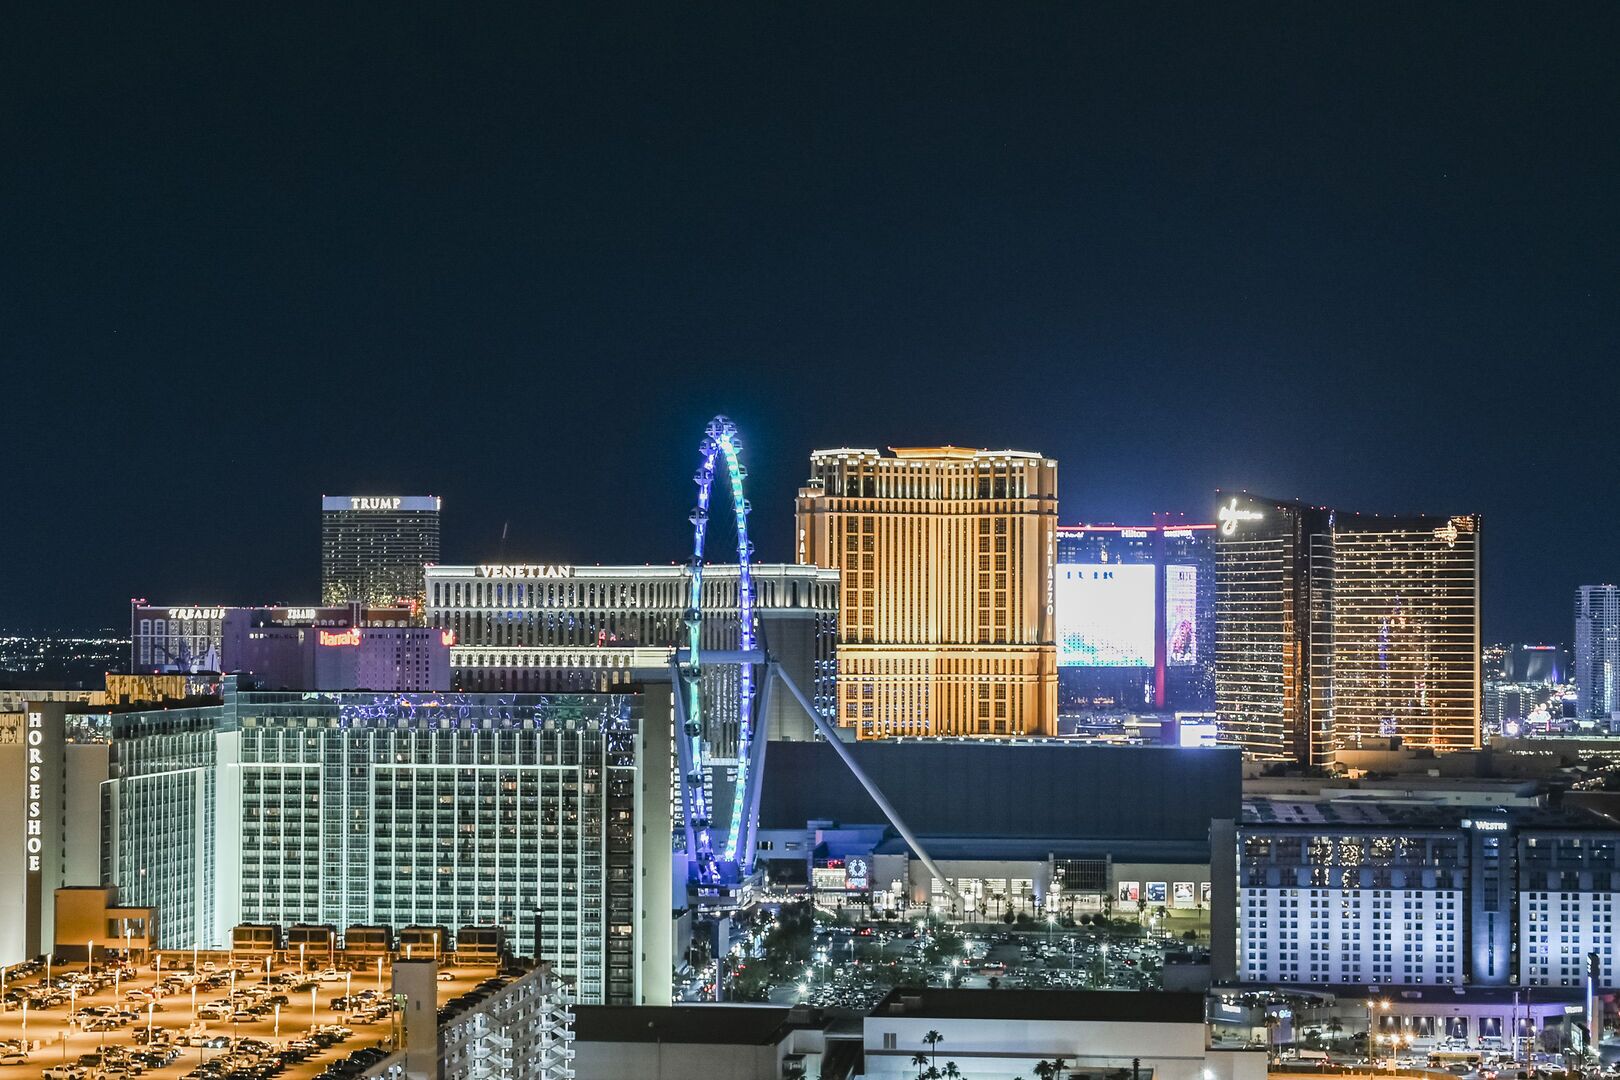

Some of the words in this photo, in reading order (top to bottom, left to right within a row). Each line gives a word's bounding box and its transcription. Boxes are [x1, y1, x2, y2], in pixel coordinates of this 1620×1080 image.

[351, 498, 400, 509] TRUMP
[1121, 529, 1147, 538] Hilton
[480, 565, 570, 578] VENETIAN
[288, 609, 315, 619] ISLAND
[27, 712, 43, 871] HORSESHOE
